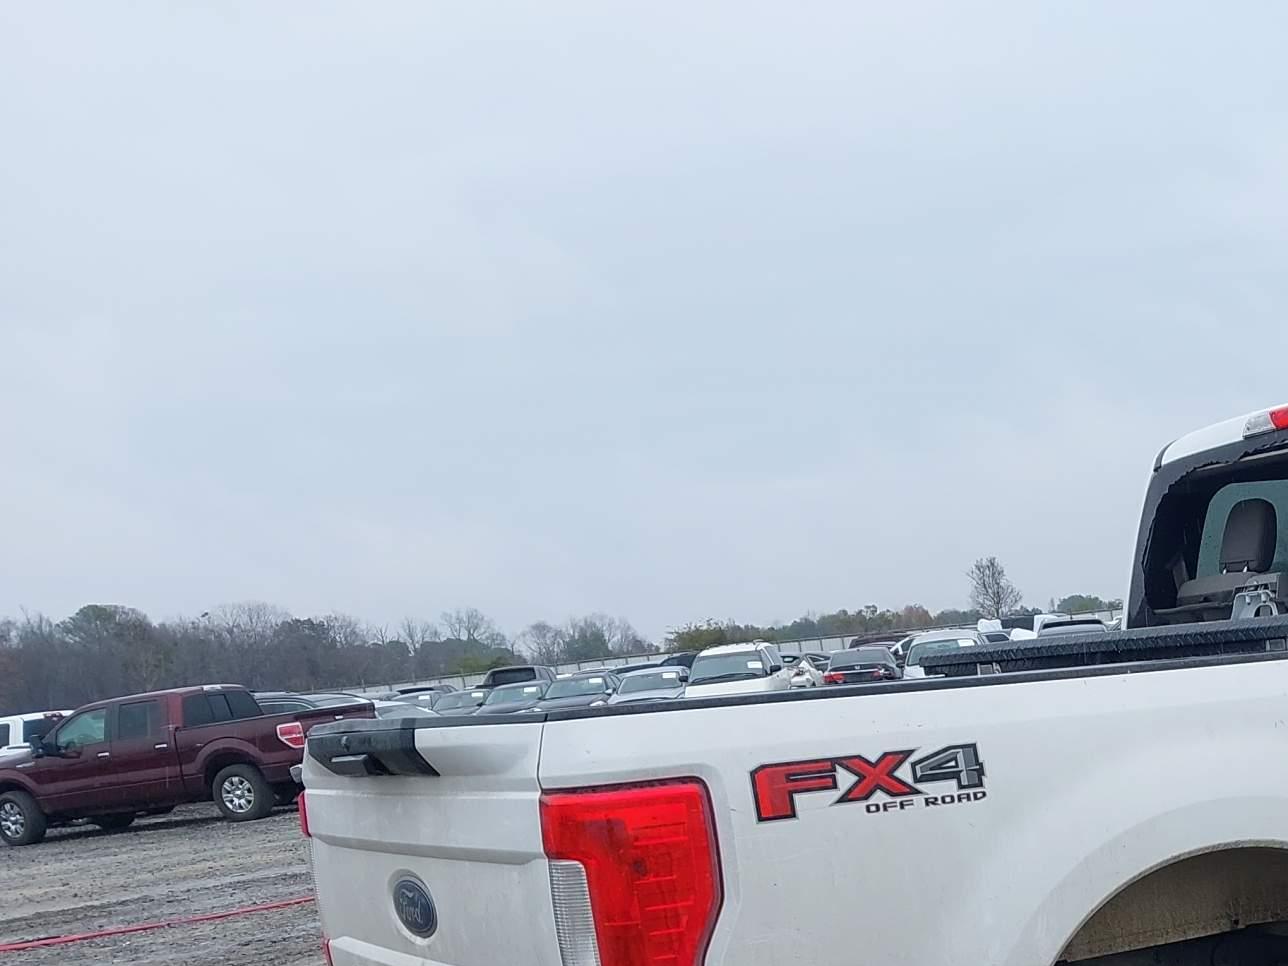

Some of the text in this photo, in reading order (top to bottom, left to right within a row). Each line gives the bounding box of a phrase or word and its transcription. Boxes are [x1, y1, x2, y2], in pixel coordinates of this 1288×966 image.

[750, 742, 985, 823] FX4
[865, 790, 988, 814] OFF ROAD
